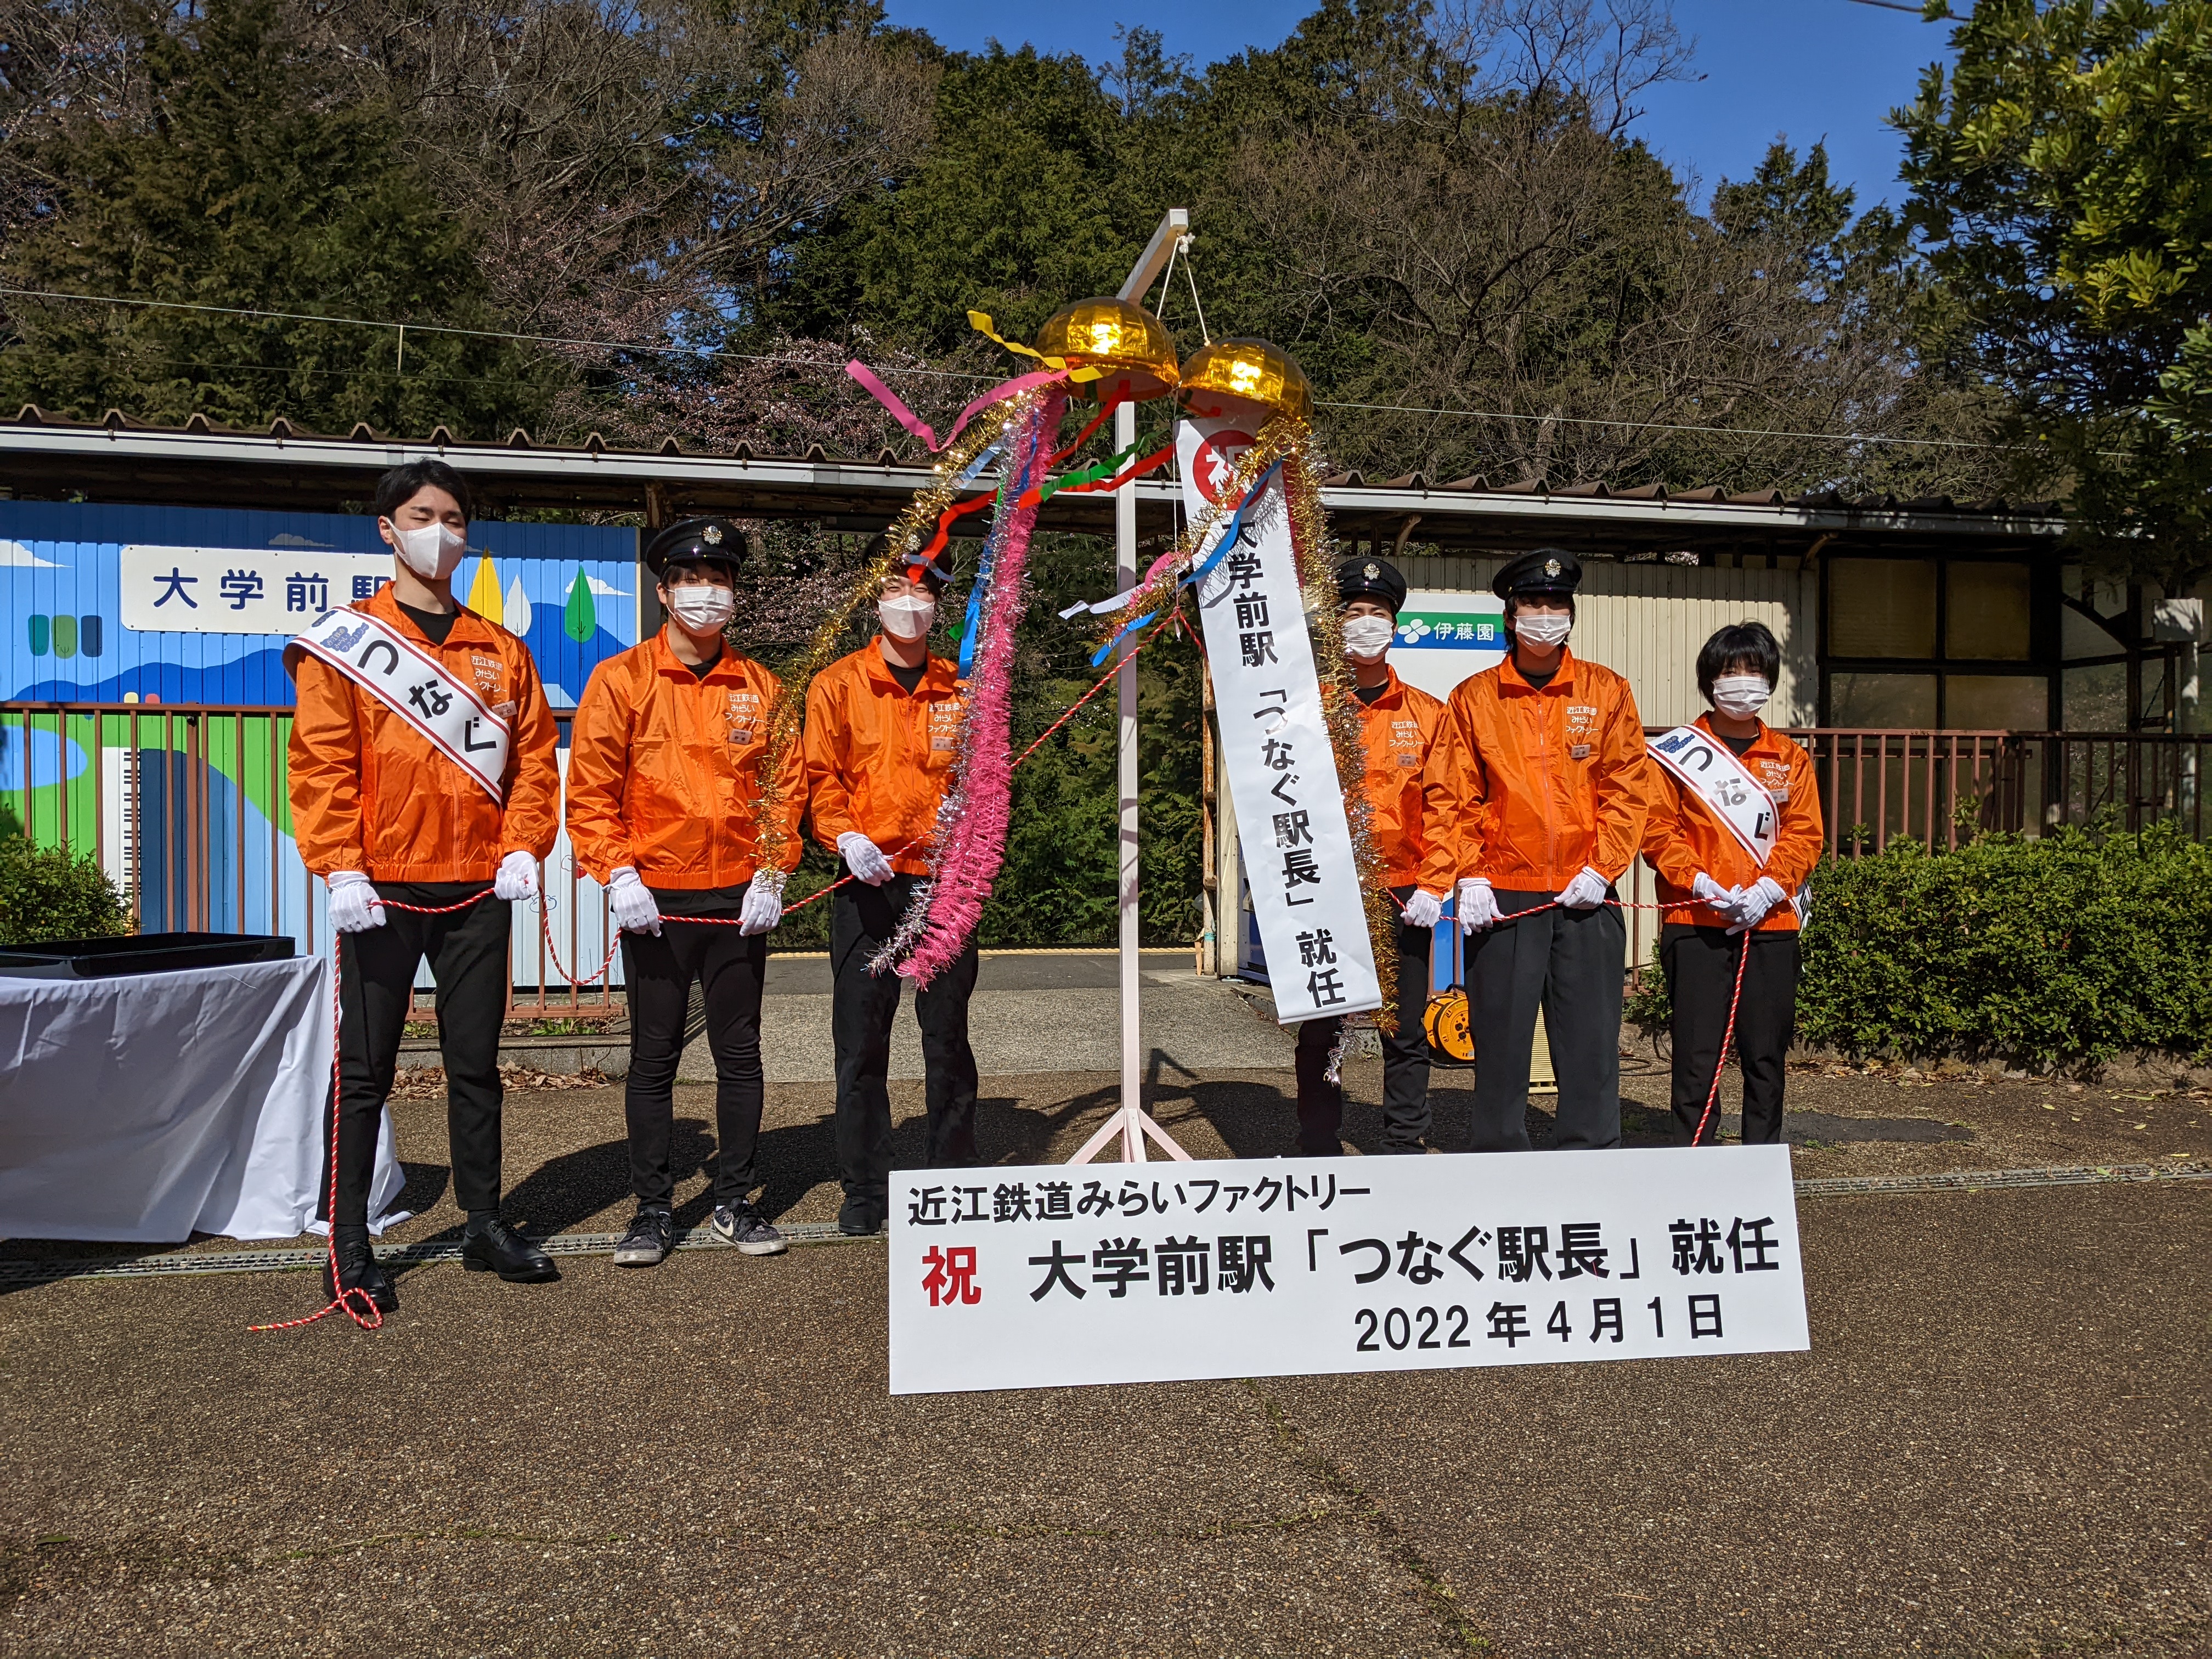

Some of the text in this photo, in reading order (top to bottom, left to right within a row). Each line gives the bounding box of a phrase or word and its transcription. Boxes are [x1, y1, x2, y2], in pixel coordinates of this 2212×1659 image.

[1434, 622, 1494, 641] 伊藤園
[475, 669, 500, 680] みらい
[357, 640, 497, 753] つなぐ
[731, 704, 755, 713] みらい
[1566, 706, 1597, 715] 近江鉄道
[725, 712, 765, 724] ファクトリー
[934, 713, 956, 722] みらい
[1571, 716, 1593, 724] みらい
[1396, 730, 1417, 738] みらい
[1565, 725, 1599, 735] ファクトリー
[1389, 740, 1425, 748] ファクトリー
[1766, 770, 1787, 780] みらい
[1760, 777, 1795, 787] ファクトリー
[1678, 746, 1771, 840] つなぐ
[908, 1173, 1370, 1226] 近江鉄道みらいファクトリー
[922, 1245, 981, 1307] 祝
